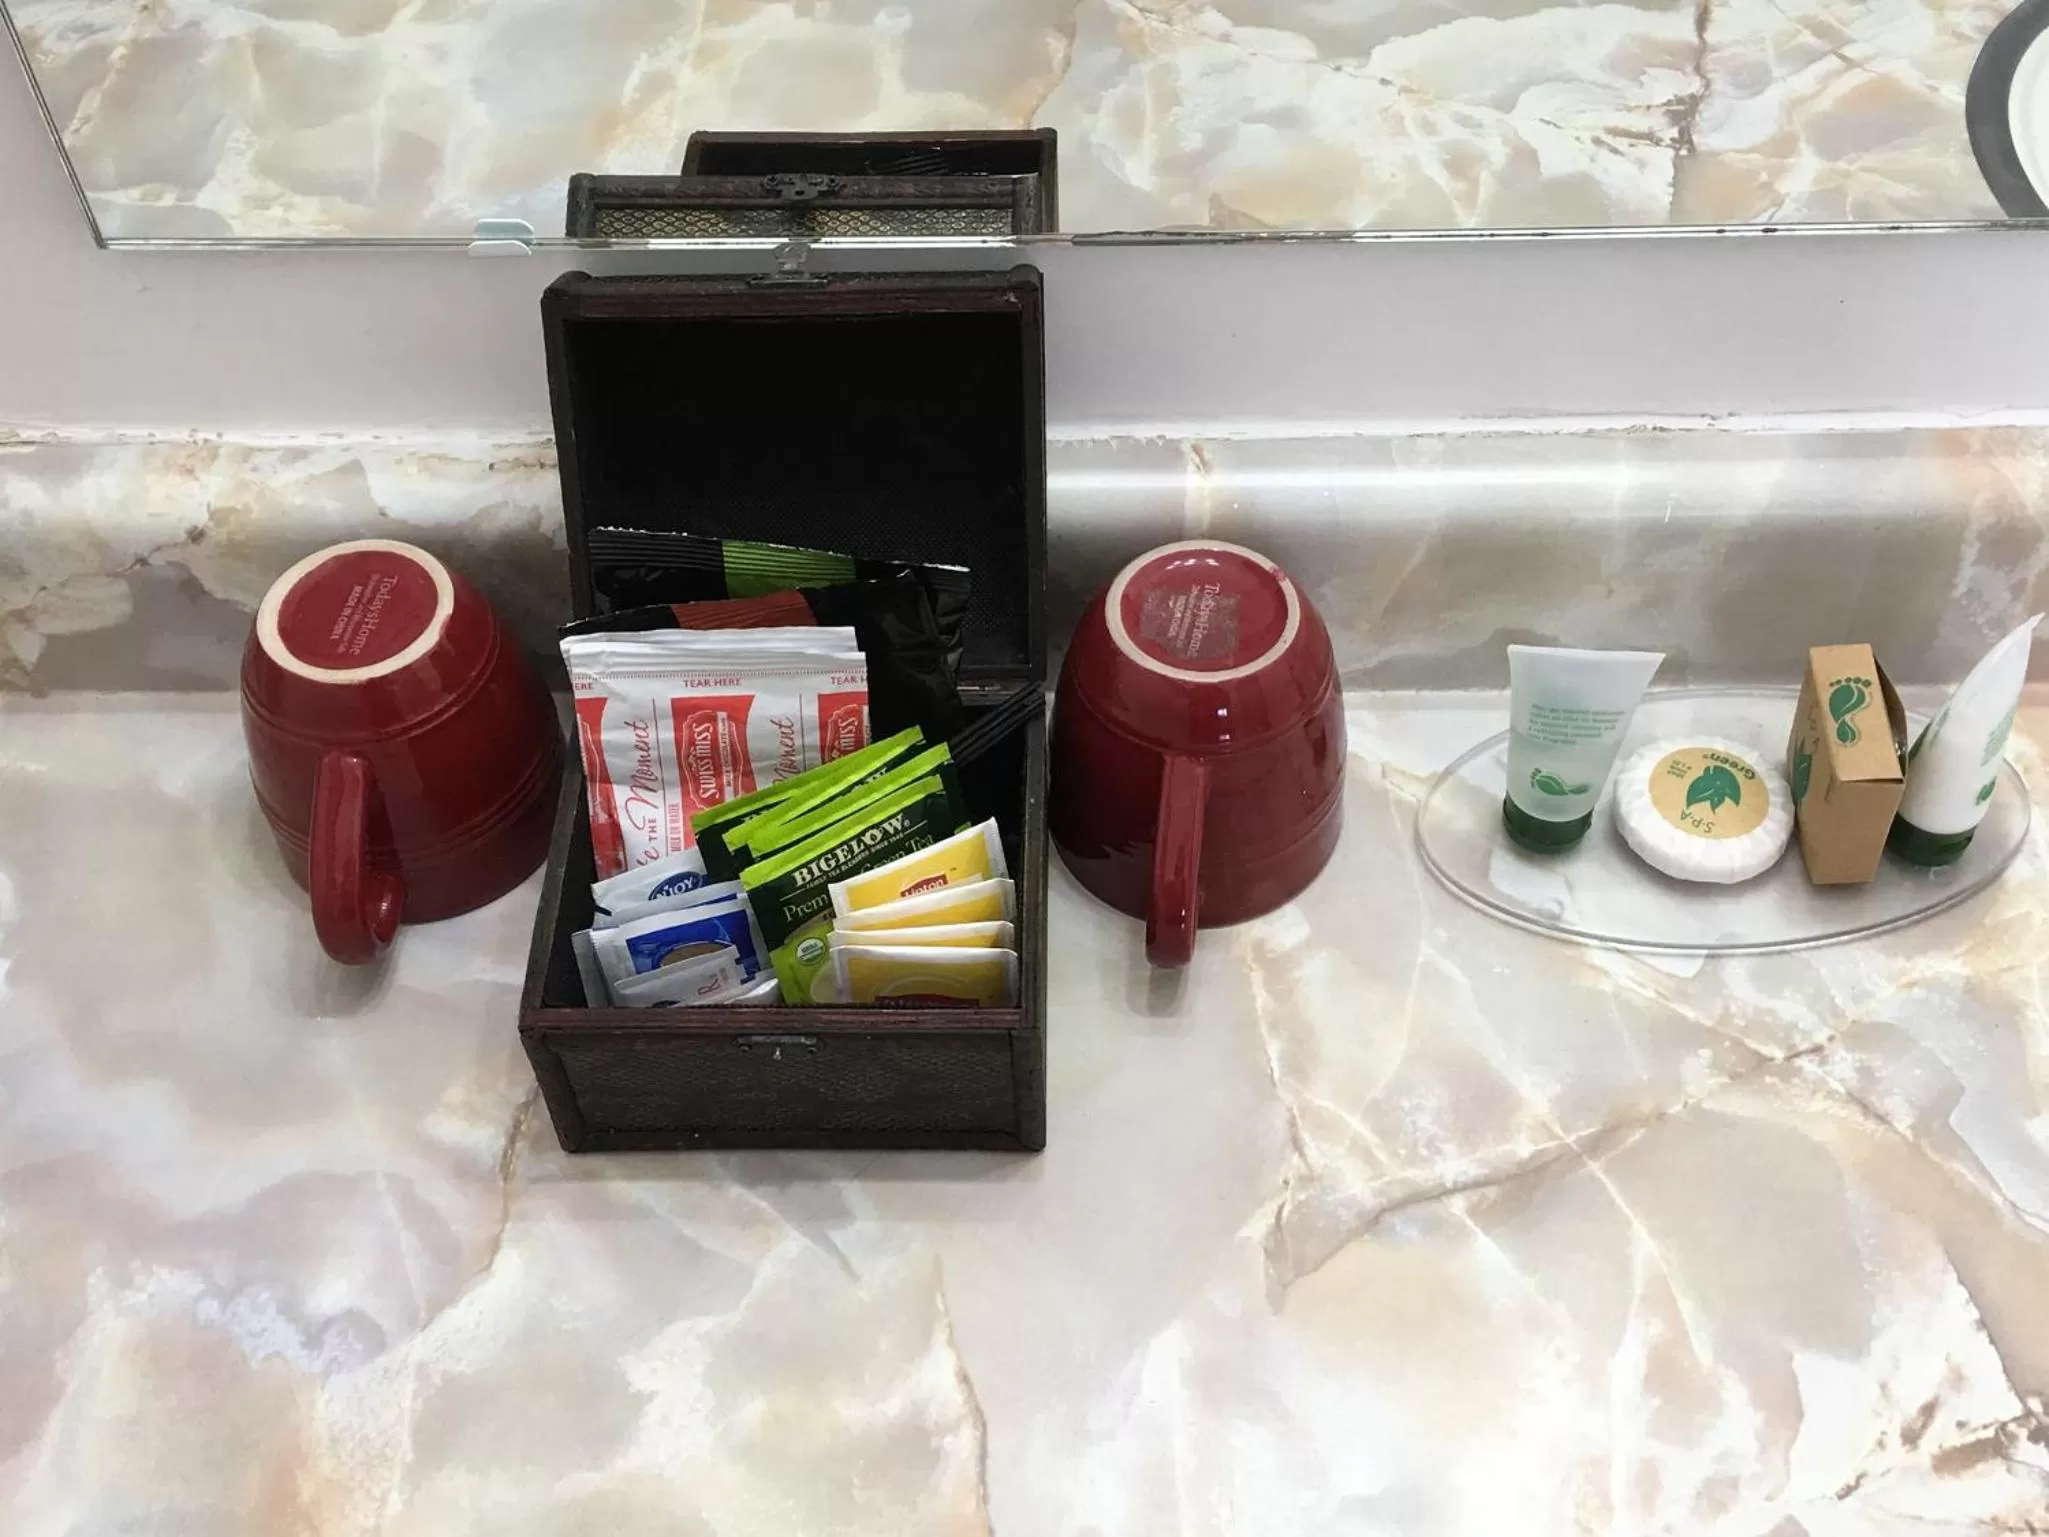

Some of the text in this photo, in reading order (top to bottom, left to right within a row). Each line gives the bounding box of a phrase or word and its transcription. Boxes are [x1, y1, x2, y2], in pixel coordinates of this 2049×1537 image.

[683, 677, 742, 688] TEAR HERE
[830, 675, 858, 685] TEAR
[624, 718, 659, 831] Moment
[692, 722, 720, 799] SWISS MISS
[1709, 752, 1756, 780] Green
[648, 818, 658, 842] THE
[792, 813, 905, 887] BIGELOW
